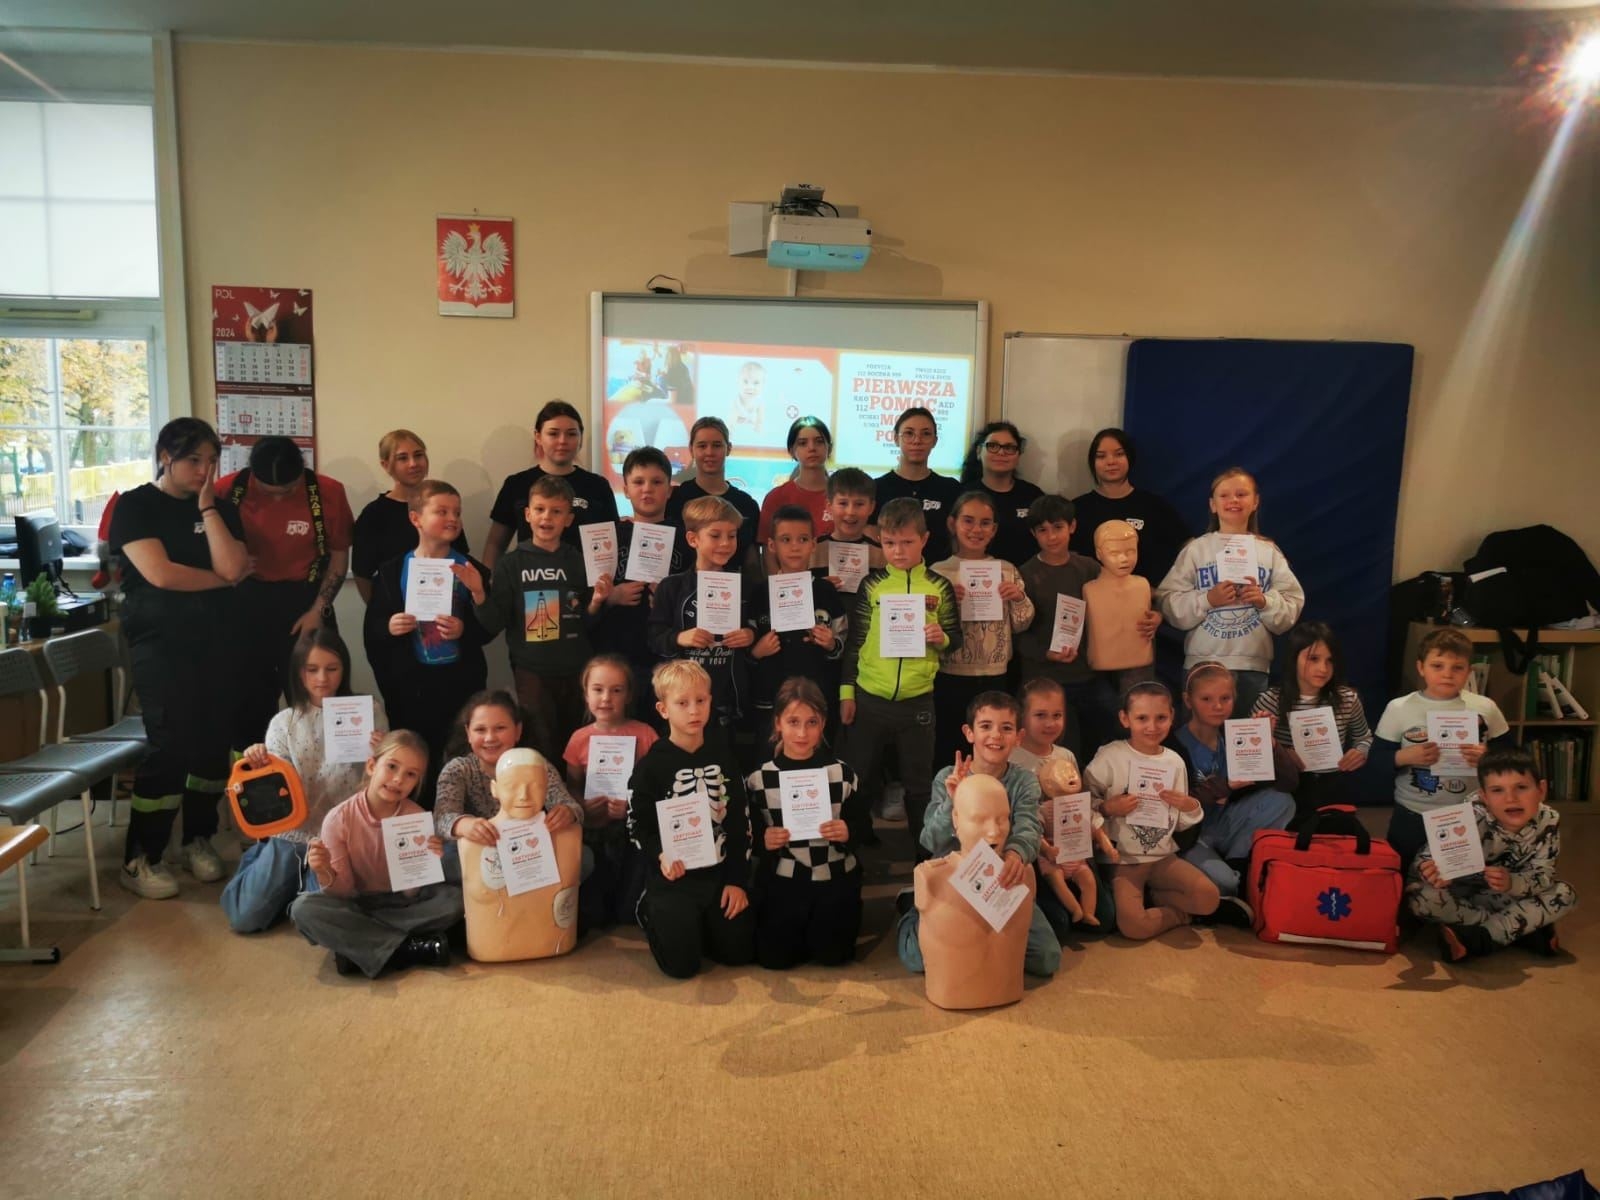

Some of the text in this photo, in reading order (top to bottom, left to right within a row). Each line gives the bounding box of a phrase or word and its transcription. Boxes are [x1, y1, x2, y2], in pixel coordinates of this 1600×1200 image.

[215, 328, 236, 338] 2024
[852, 378, 956, 396] PIERWSZA
[522, 568, 568, 582] NASA
[1220, 618, 1260, 640] DEPARTM
